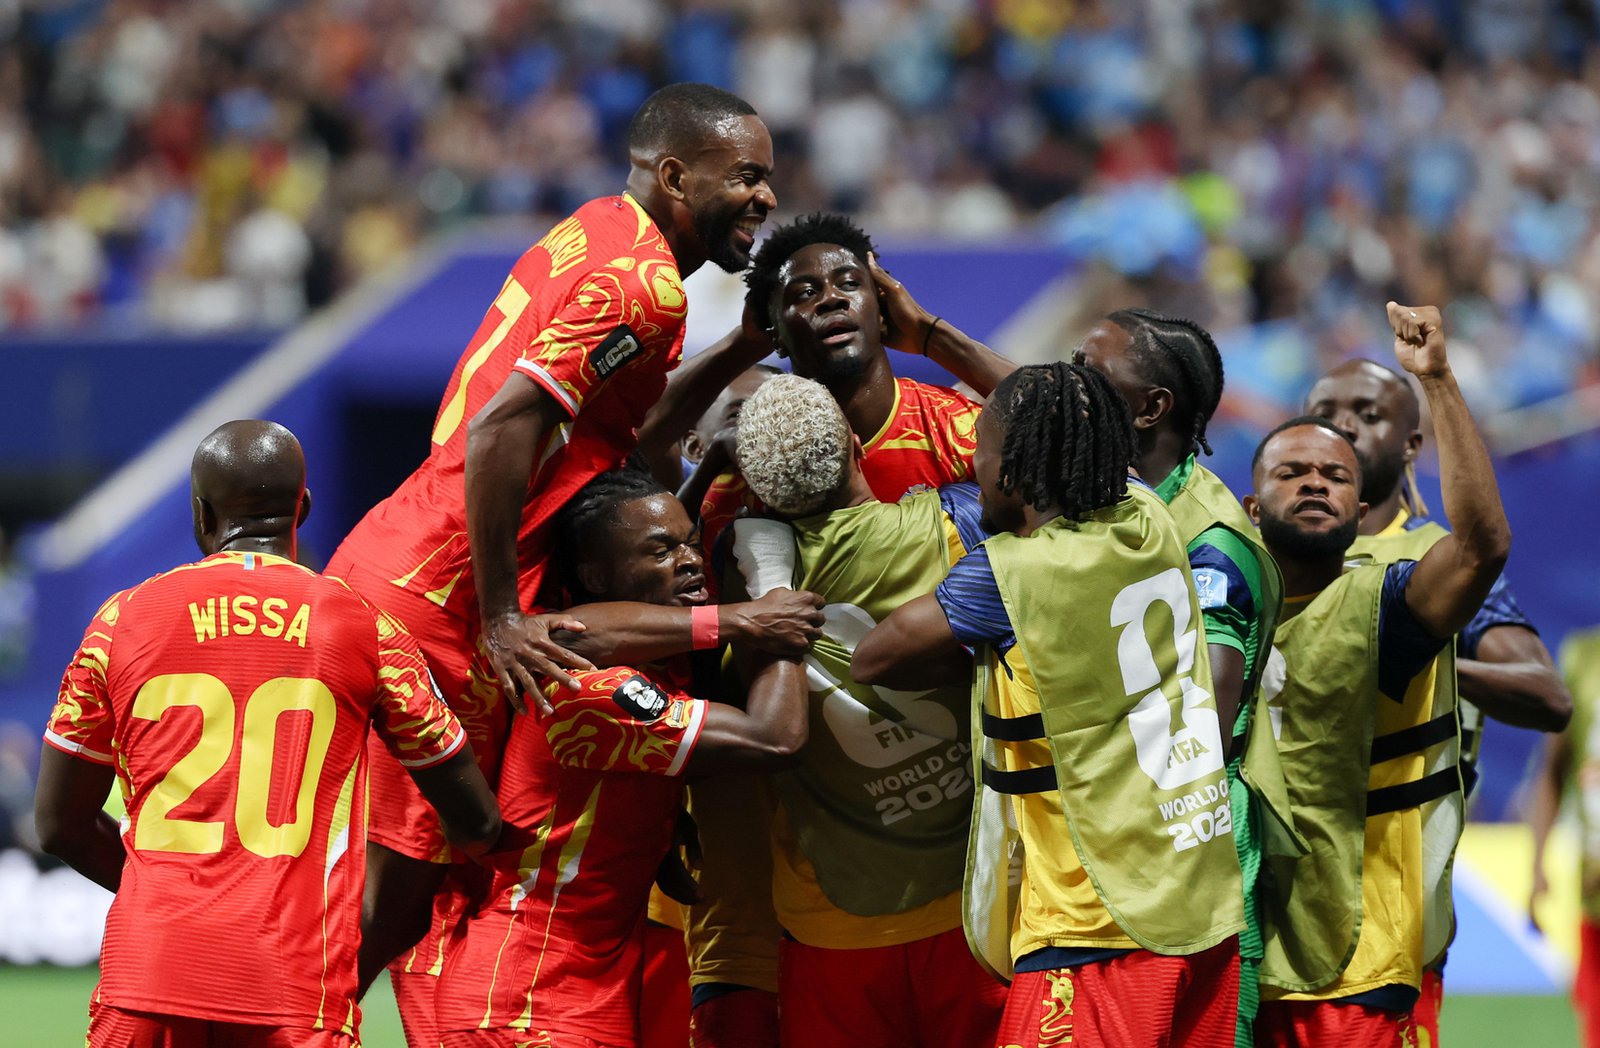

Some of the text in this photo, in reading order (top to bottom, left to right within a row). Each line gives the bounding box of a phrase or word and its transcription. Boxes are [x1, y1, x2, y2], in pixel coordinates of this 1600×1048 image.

[188, 596, 310, 648] WISSA
[132, 673, 336, 858] 20
[864, 742, 971, 797] WORLD CU
[876, 757, 974, 826] 202
[1159, 784, 1219, 821] WORLD
[1168, 800, 1232, 853] 202
